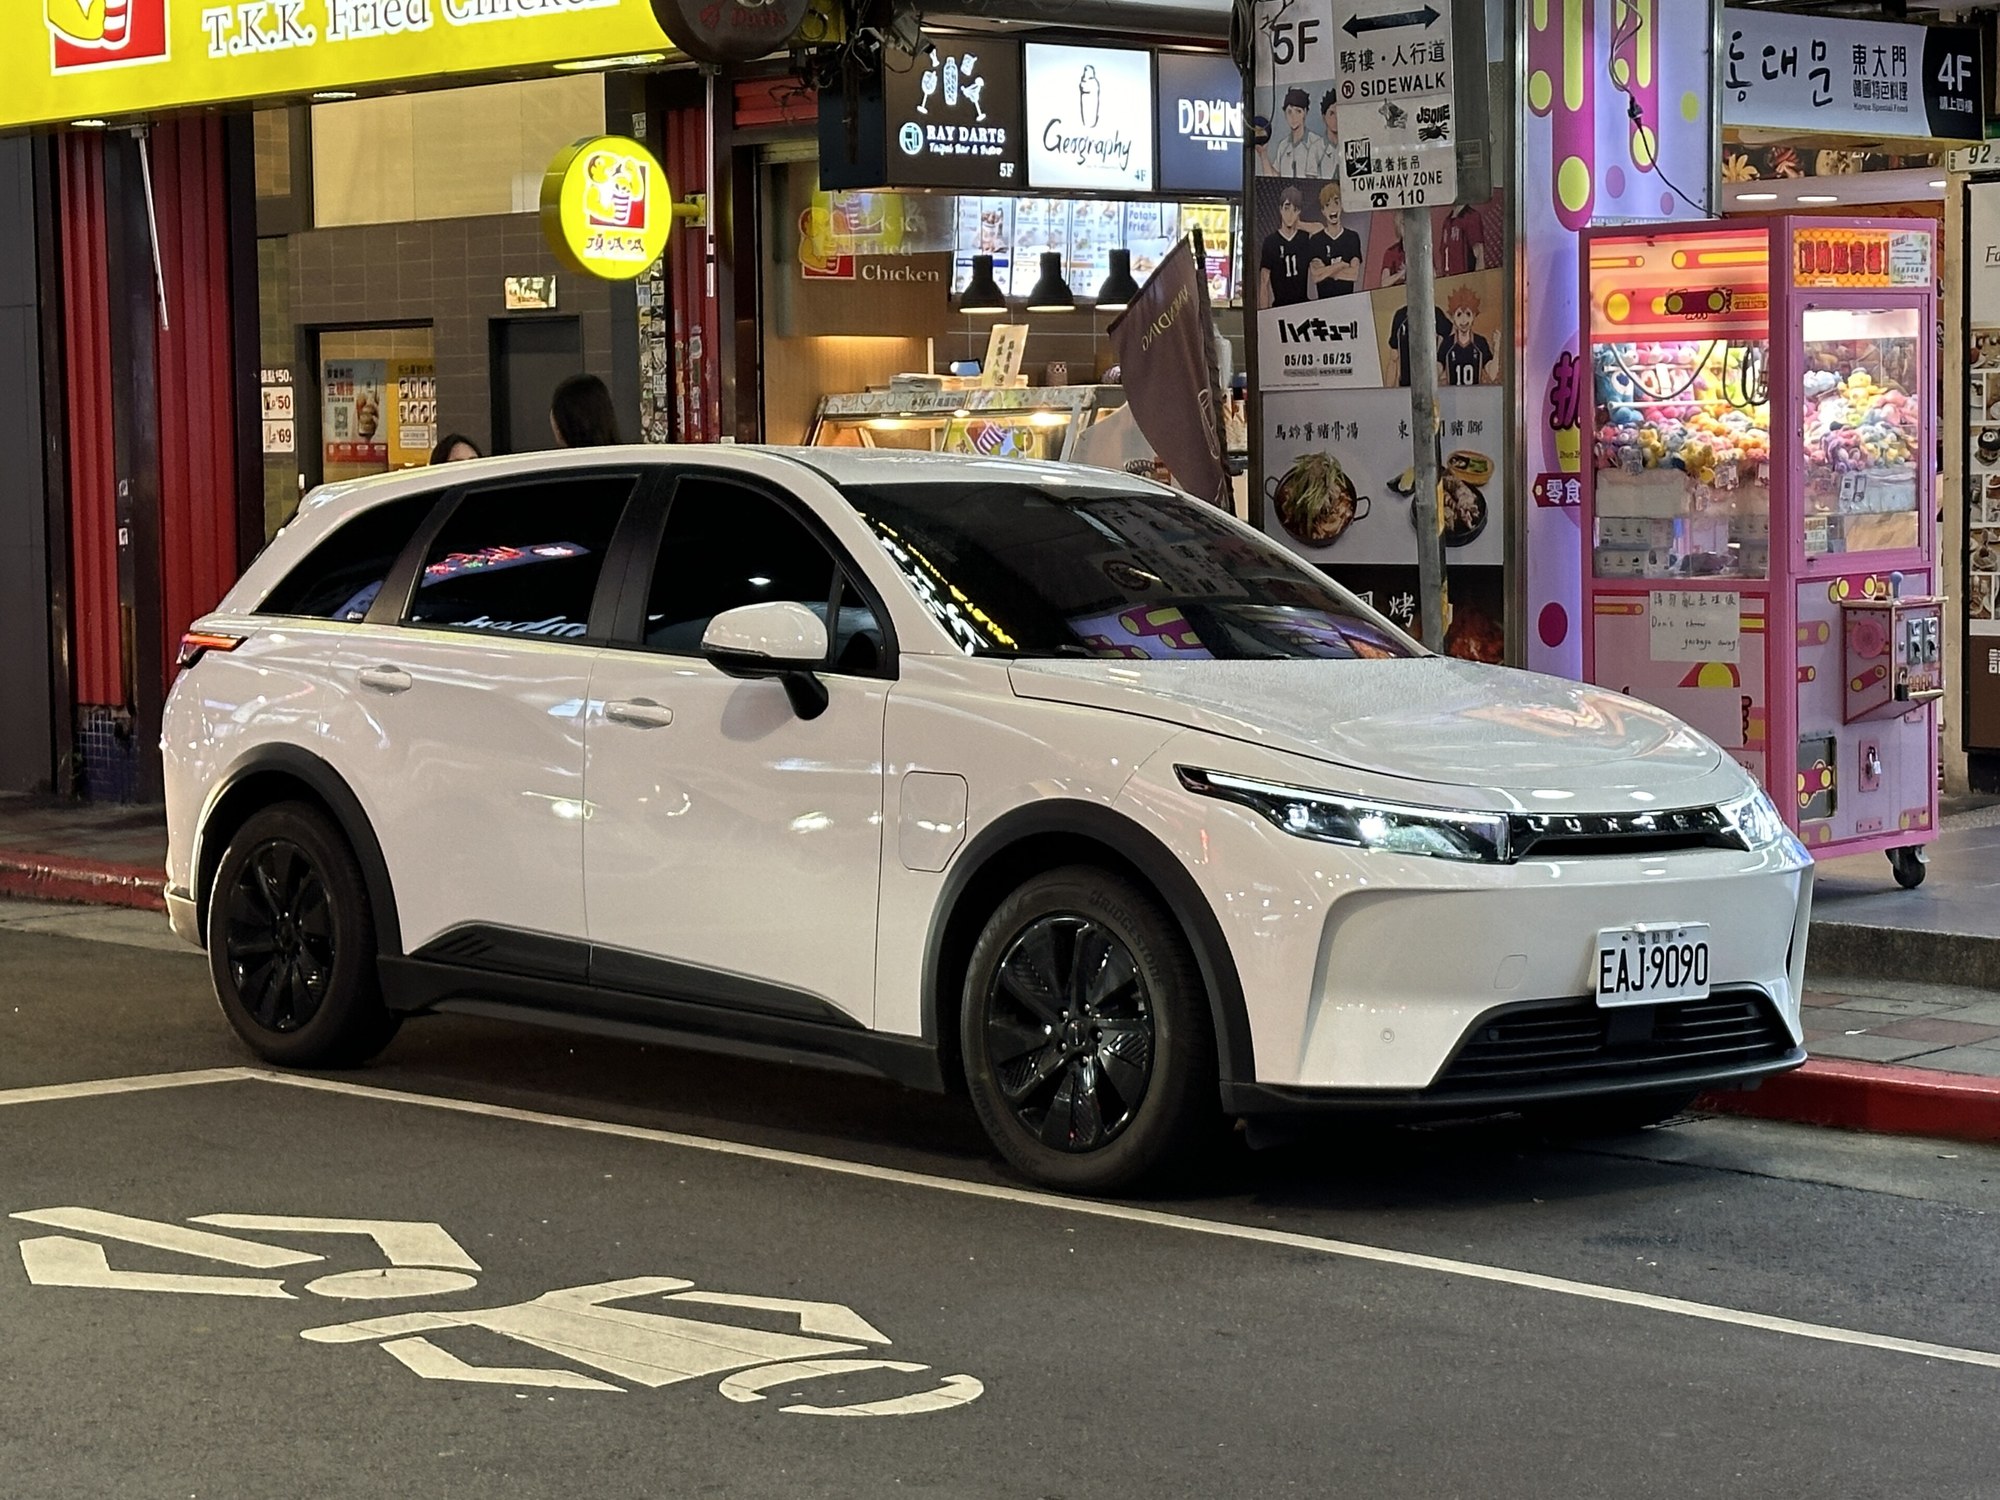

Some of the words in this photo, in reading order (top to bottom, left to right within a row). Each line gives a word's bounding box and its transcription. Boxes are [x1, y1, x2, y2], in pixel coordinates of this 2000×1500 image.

[204, 2, 314, 52] T.K.K.
[331, 0, 429, 36] Fried
[1271, 19, 1320, 65] 5F
[1852, 44, 1907, 78] 東大門
[1938, 52, 1973, 92] 4F
[1361, 71, 1446, 97] SIDEWALK
[1178, 98, 1244, 138] DRUN
[926, 125, 956, 141] RAY
[958, 126, 1006, 144] DARTS
[1043, 118, 1132, 171] Geography
[1207, 141, 1228, 151] BAR
[1968, 143, 1991, 165] 92
[999, 162, 1015, 178] 5F
[1352, 173, 1409, 191] TOW-AWAY
[1413, 171, 1443, 186] ZONE
[1397, 188, 1425, 205] 110
[861, 264, 940, 282] Chicken
[1285, 254, 1298, 277] 11
[1284, 353, 1314, 366] 05/03
[1322, 352, 1352, 366] 06/25
[1455, 364, 1474, 386] 10
[1397, 419, 1484, 441] 東豬腳
[1546, 478, 1581, 505] 零食
[1600, 942, 1709, 995] EAJ-9090
